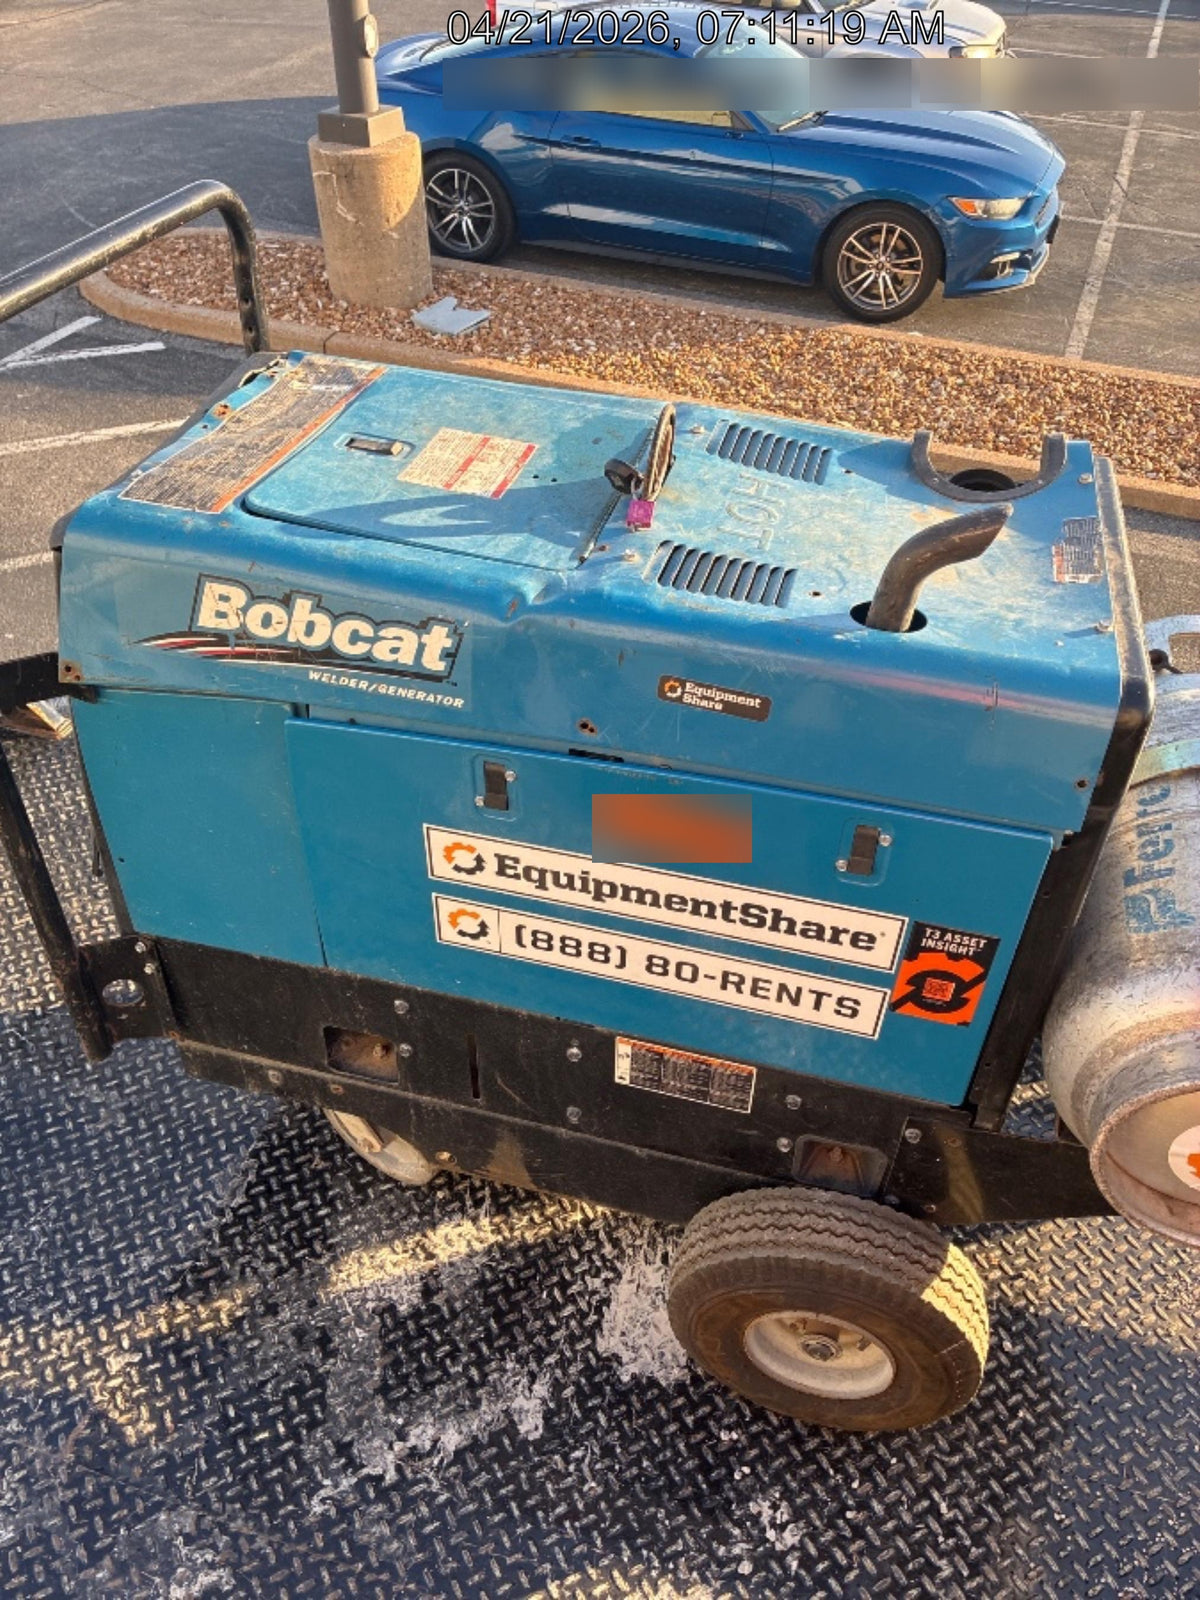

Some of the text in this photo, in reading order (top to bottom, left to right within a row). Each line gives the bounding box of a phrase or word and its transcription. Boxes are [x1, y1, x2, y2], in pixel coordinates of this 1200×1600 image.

[716, 472, 790, 551] HOT
[197, 581, 453, 671] Bobcat
[308, 670, 465, 709] WELDER/GENERATOR
[682, 692, 723, 710] Share
[684, 681, 762, 709] Equipment
[494, 852, 878, 952] EquipmentShare
[920, 938, 977, 956] INSIGHT
[925, 927, 987, 948] T3 ASSET
[514, 924, 861, 1020] (888) 80-RENTS
